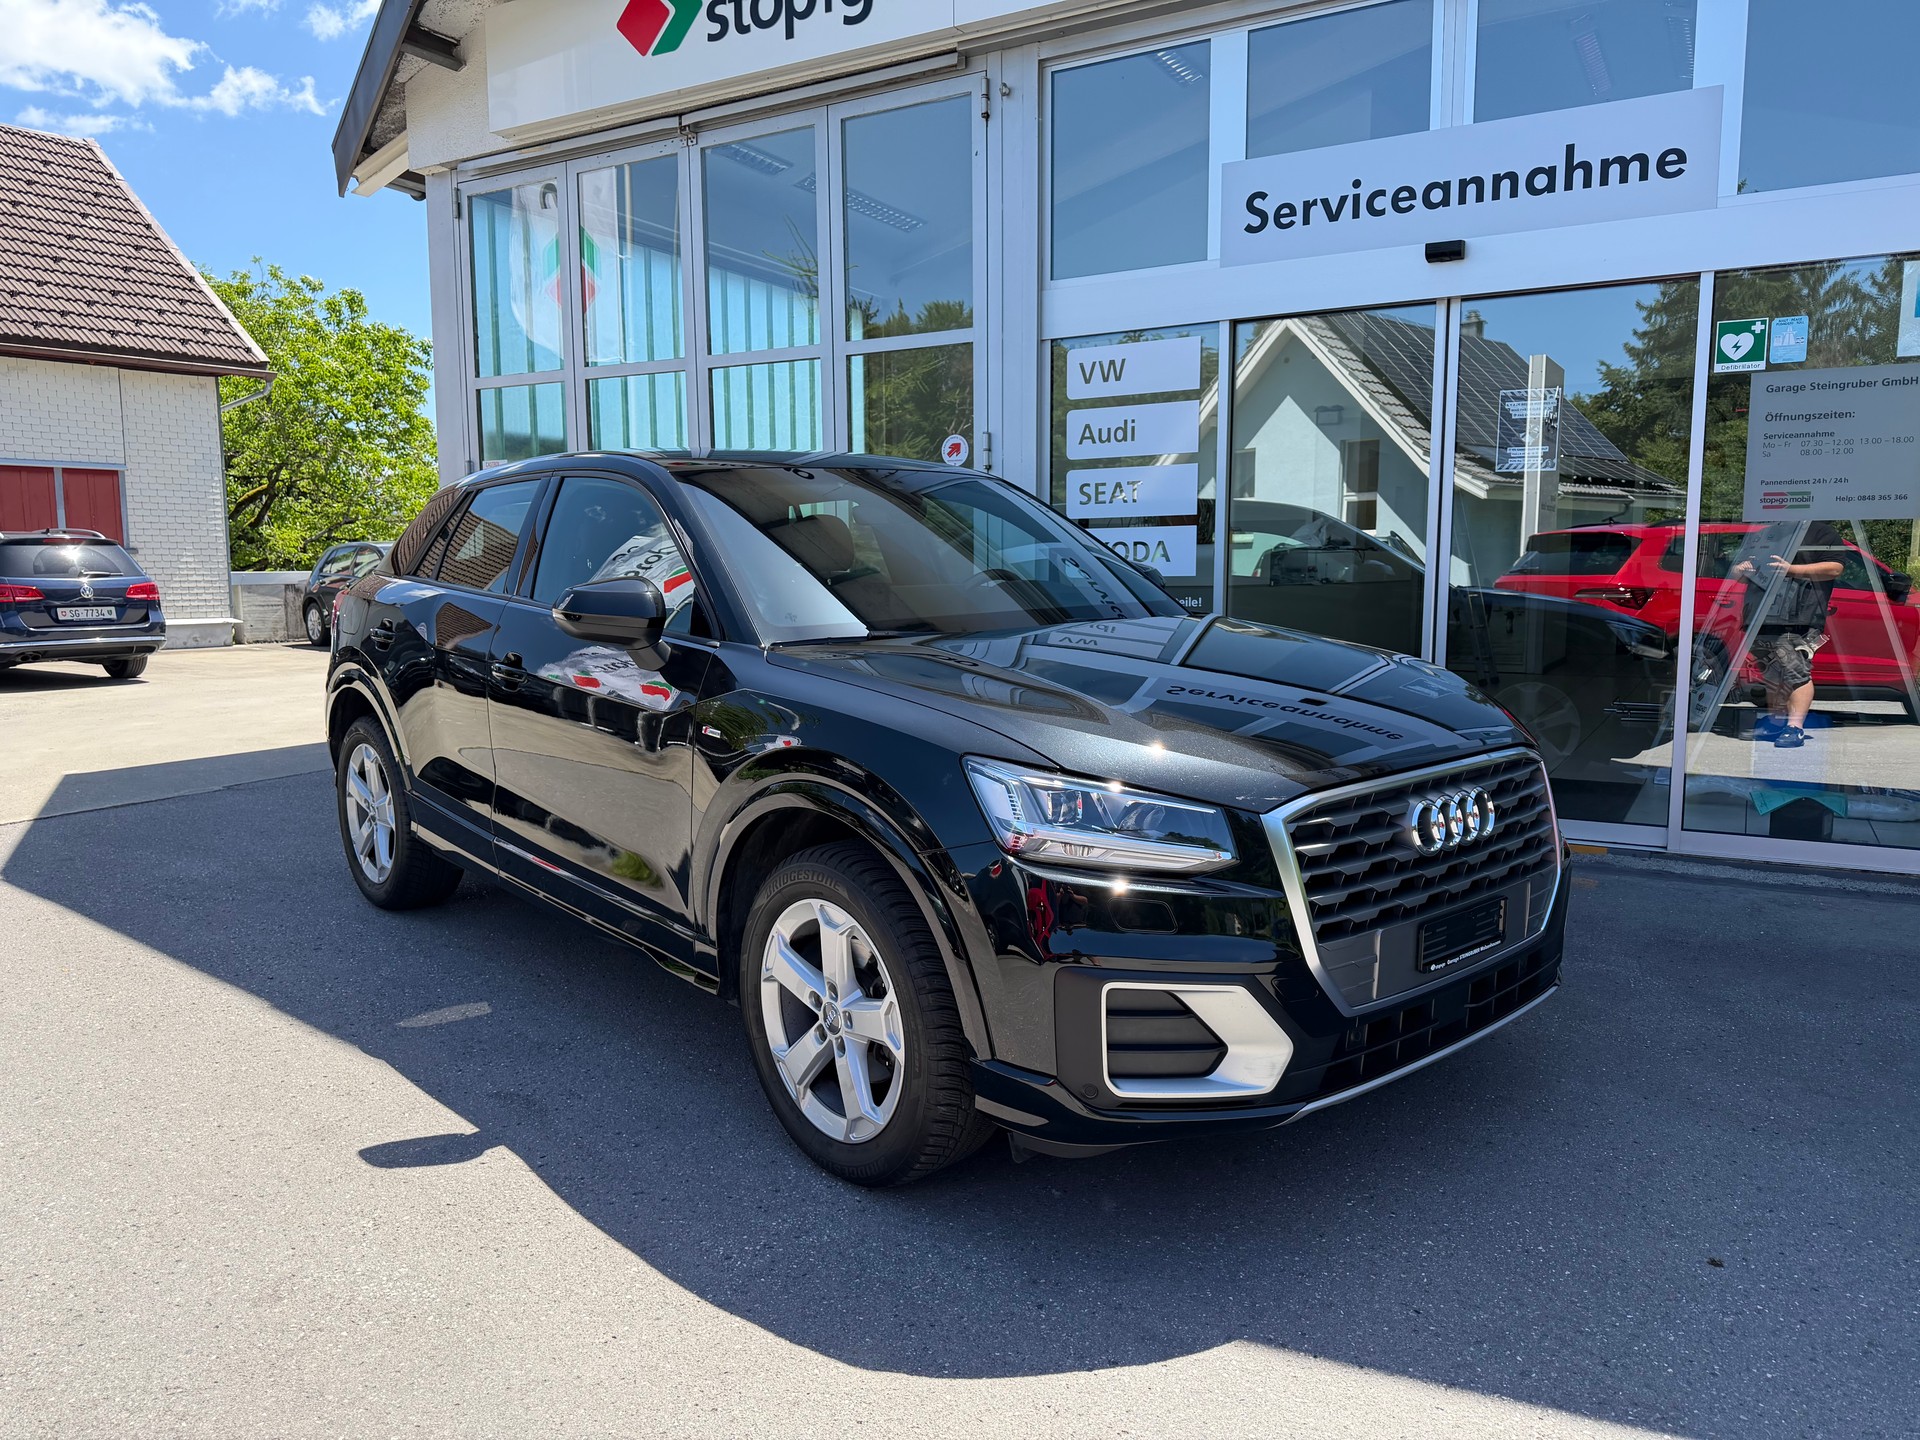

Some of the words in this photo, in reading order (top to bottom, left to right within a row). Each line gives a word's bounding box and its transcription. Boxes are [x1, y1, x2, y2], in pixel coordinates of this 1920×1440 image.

[1243, 143, 1688, 234] Serviceannahme
[1079, 358, 1126, 384] VW
[1766, 384, 1806, 394] Garage
[1809, 380, 1878, 392] Steingruber
[1881, 376, 1919, 387] GmbH
[1765, 410, 1855, 423] Öffnungszeiten:
[1078, 419, 1136, 445] Audi
[1763, 431, 1836, 440] Serviceannahme
[1860, 437, 1882, 445] 13.00
[1832, 447, 1854, 455] 12.00
[1761, 478, 1811, 486] Pannendienst
[1079, 480, 1143, 505] SEAT
[1835, 495, 1856, 503] Help:
[1105, 540, 1171, 563] ODA
[1176, 597, 1202, 607] eile!
